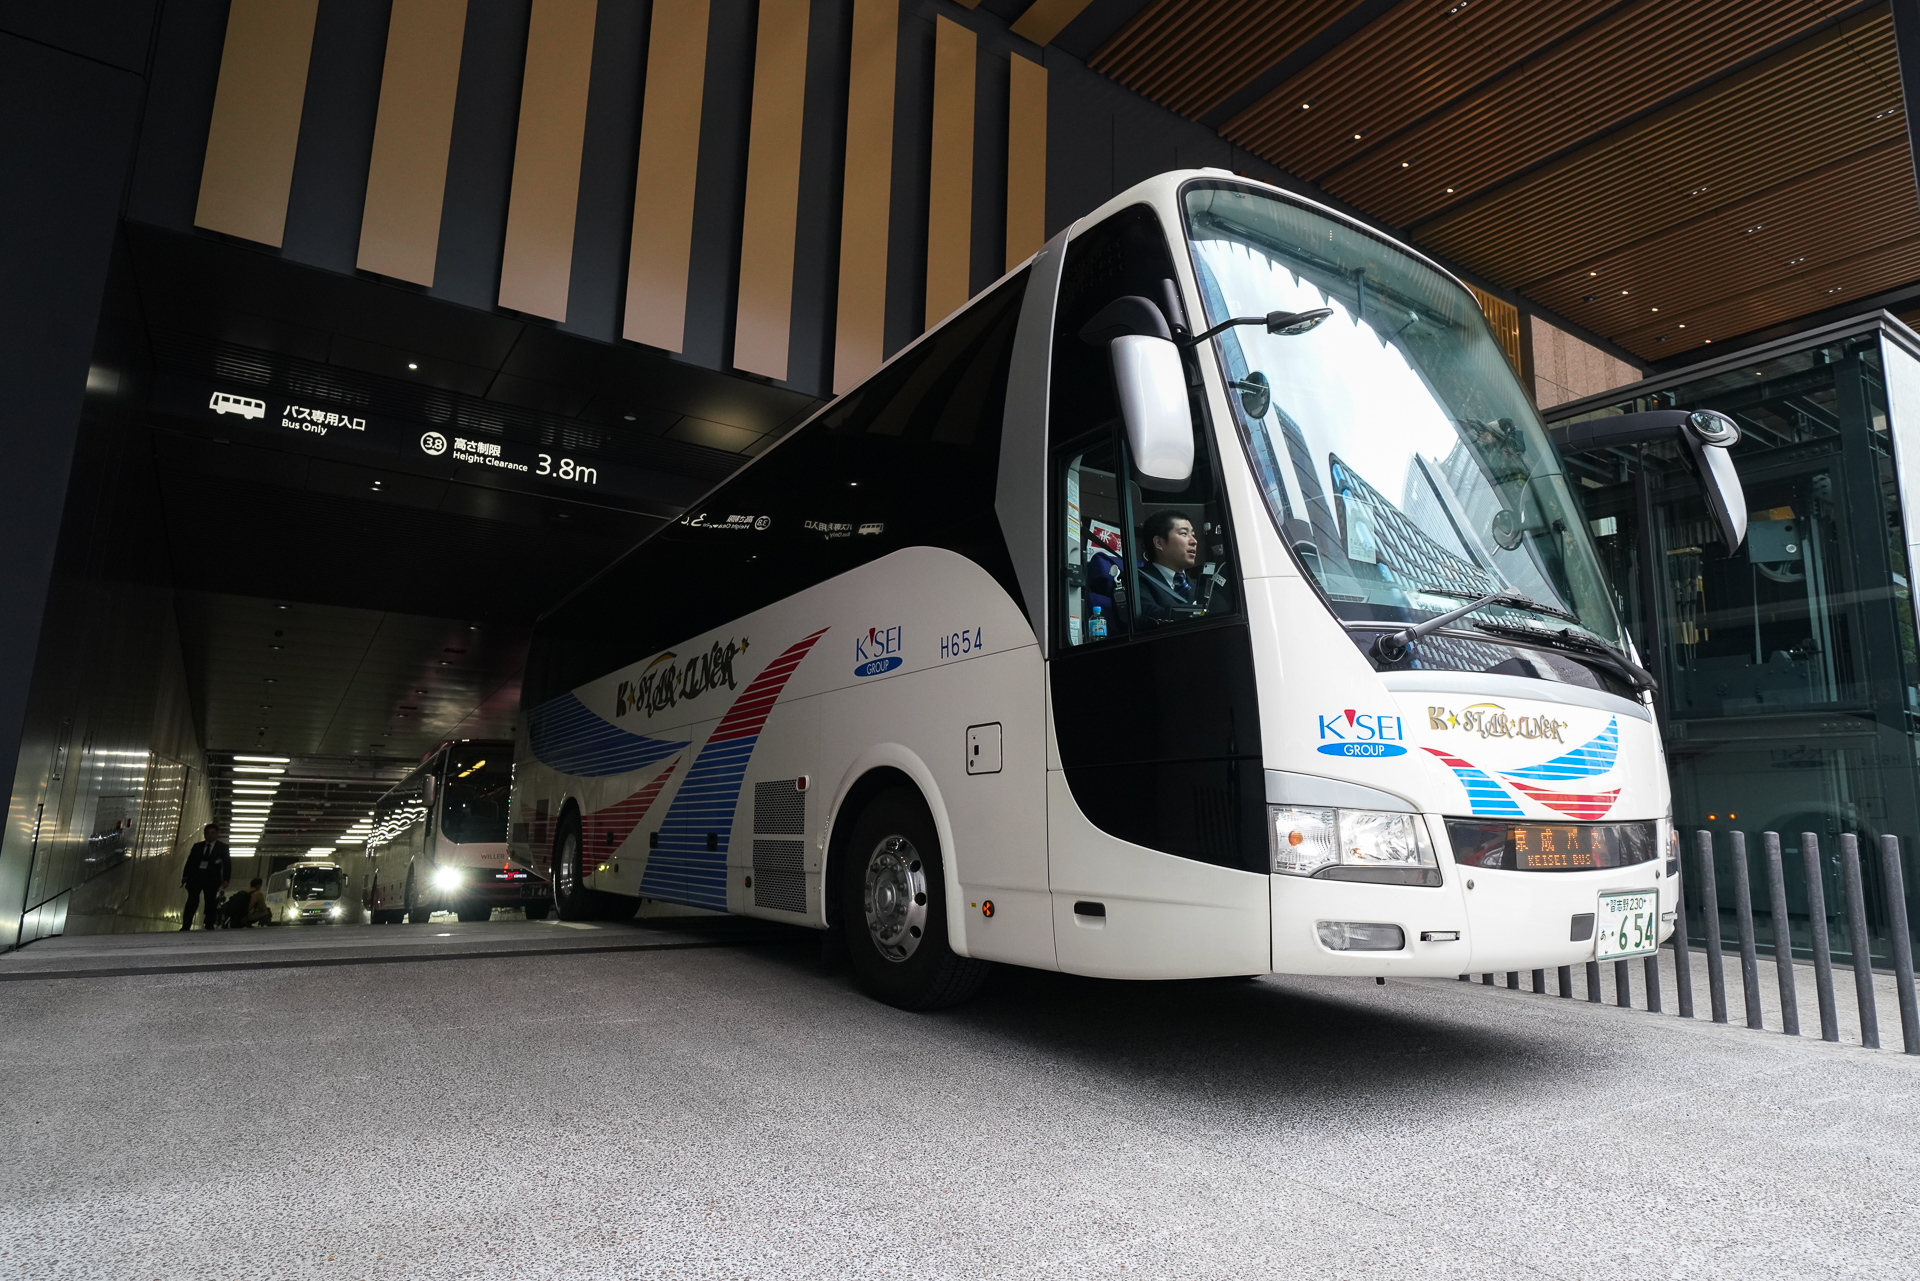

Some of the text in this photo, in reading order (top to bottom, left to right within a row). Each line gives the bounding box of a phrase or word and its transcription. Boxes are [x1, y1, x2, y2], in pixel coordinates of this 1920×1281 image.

[281, 418, 327, 436] Bus Only
[283, 405, 366, 431] バス専用入口
[424, 436, 443, 450] 3.8
[454, 438, 501, 457] 高さ制限
[453, 450, 528, 471] Height Clearance
[535, 453, 597, 485] 3.8m
[941, 627, 982, 659] H654
[866, 659, 890, 675] GROUP
[1344, 744, 1385, 756] GROUP
[1514, 828, 1602, 852] 京成バス
[1527, 854, 1591, 867] KEISEI BUS
[1619, 912, 1653, 950] 654
